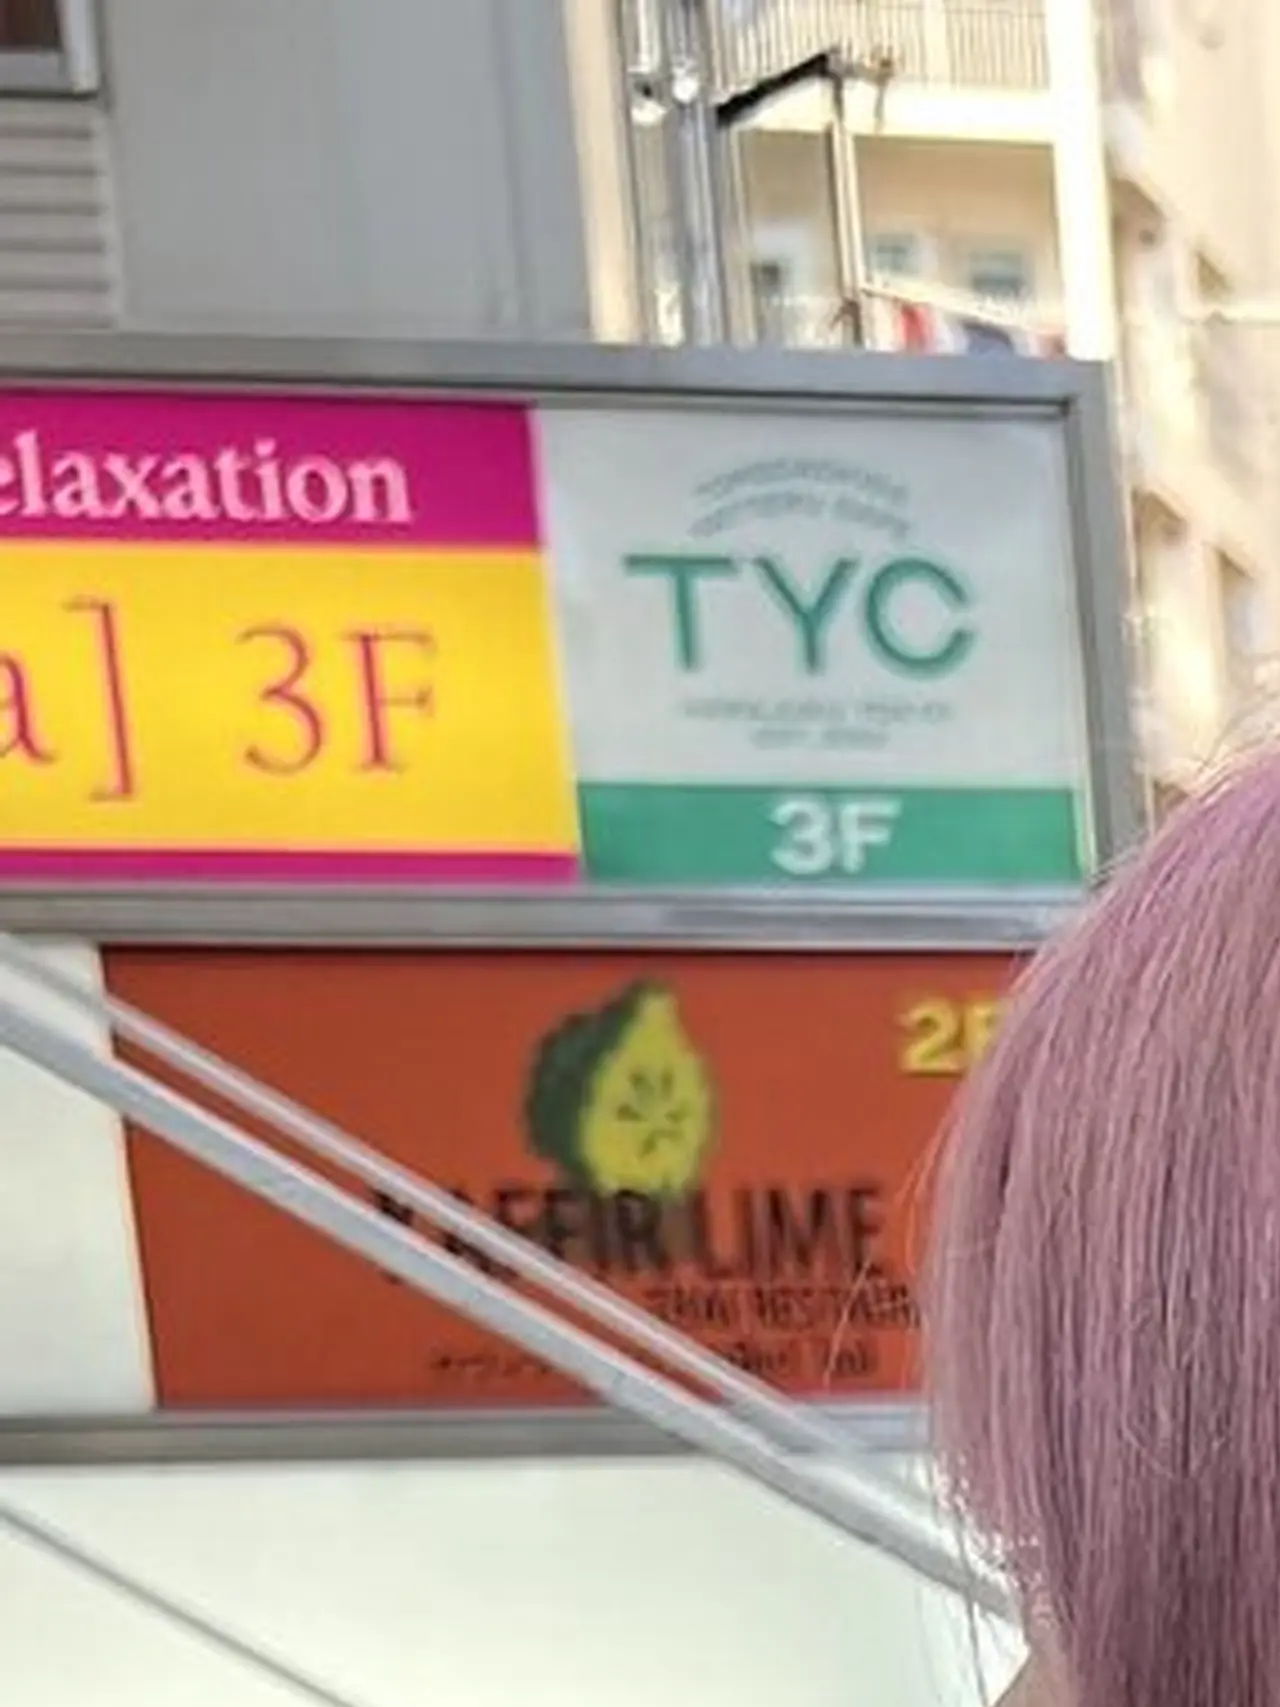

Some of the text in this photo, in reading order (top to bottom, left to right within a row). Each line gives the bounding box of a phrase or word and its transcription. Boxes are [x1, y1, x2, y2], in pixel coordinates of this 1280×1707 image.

[623, 553, 976, 679] TYC
[235, 623, 436, 774] 3F
[769, 797, 901, 876] 3F
[693, 1185, 884, 1278] LIME
